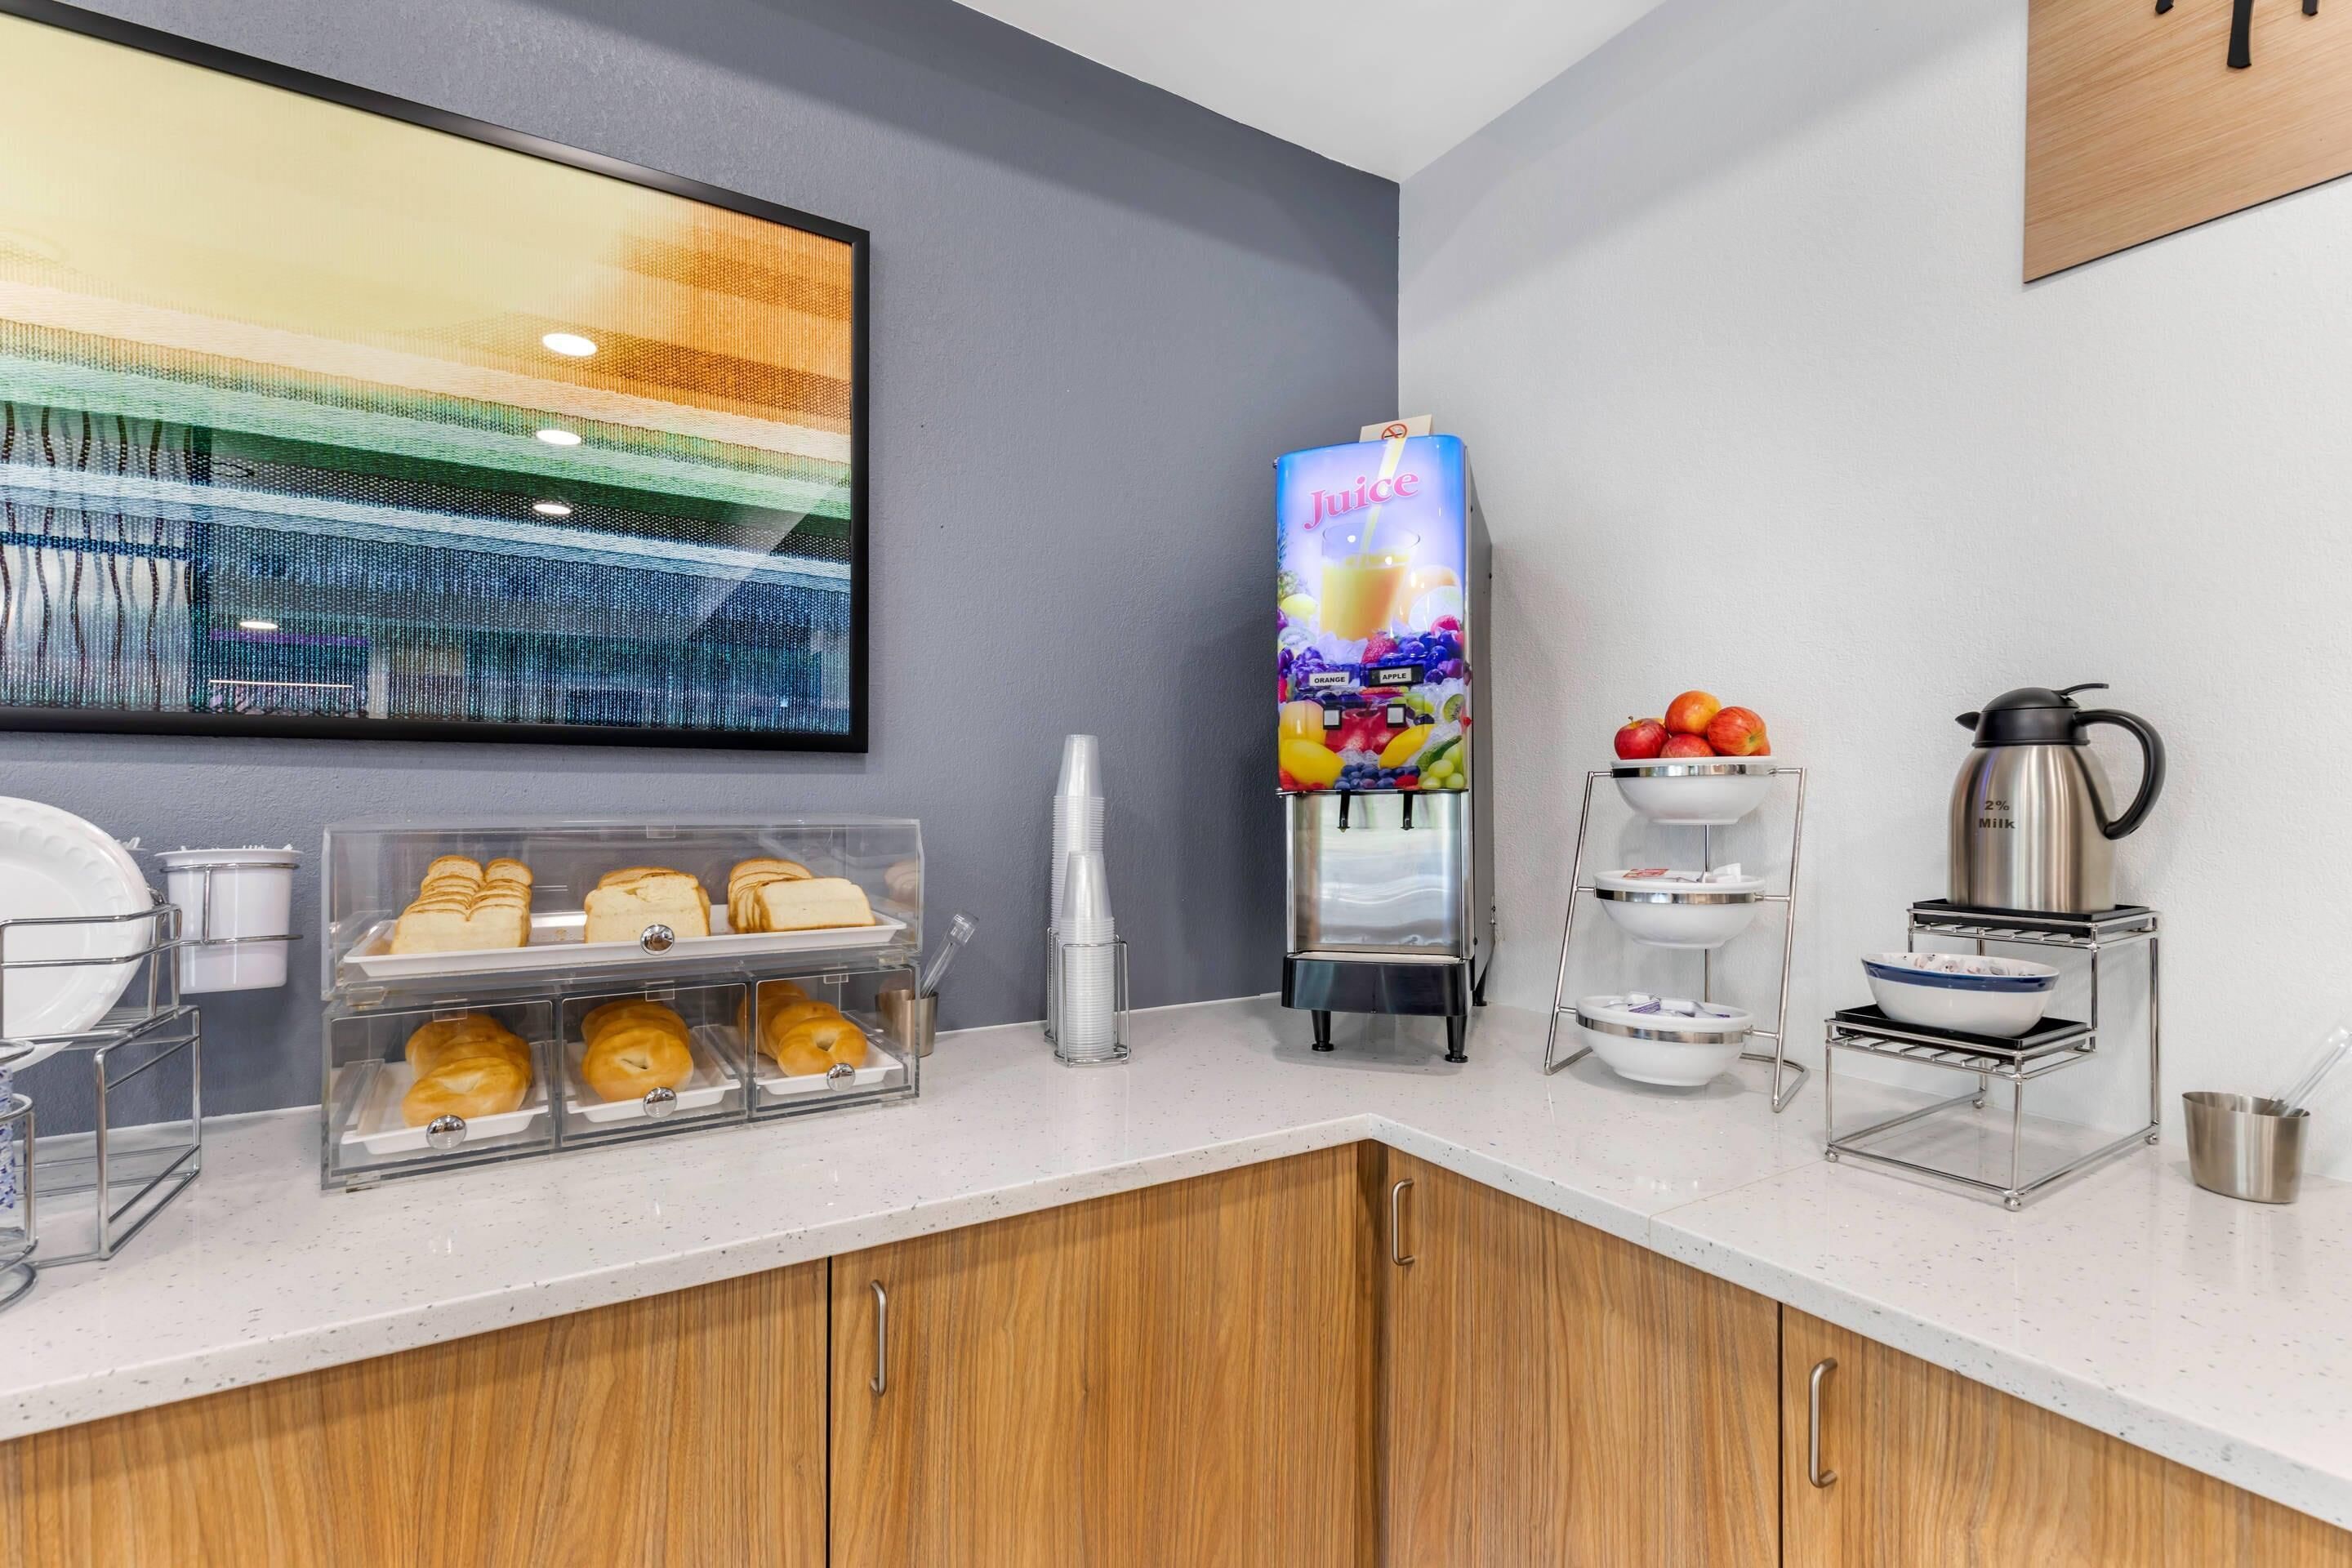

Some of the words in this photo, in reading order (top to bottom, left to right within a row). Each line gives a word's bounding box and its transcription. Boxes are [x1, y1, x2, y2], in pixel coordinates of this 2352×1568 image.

[1303, 473, 1420, 530] Juice
[1984, 800, 2010, 811] 2%
[1979, 817, 2016, 829] Milk
